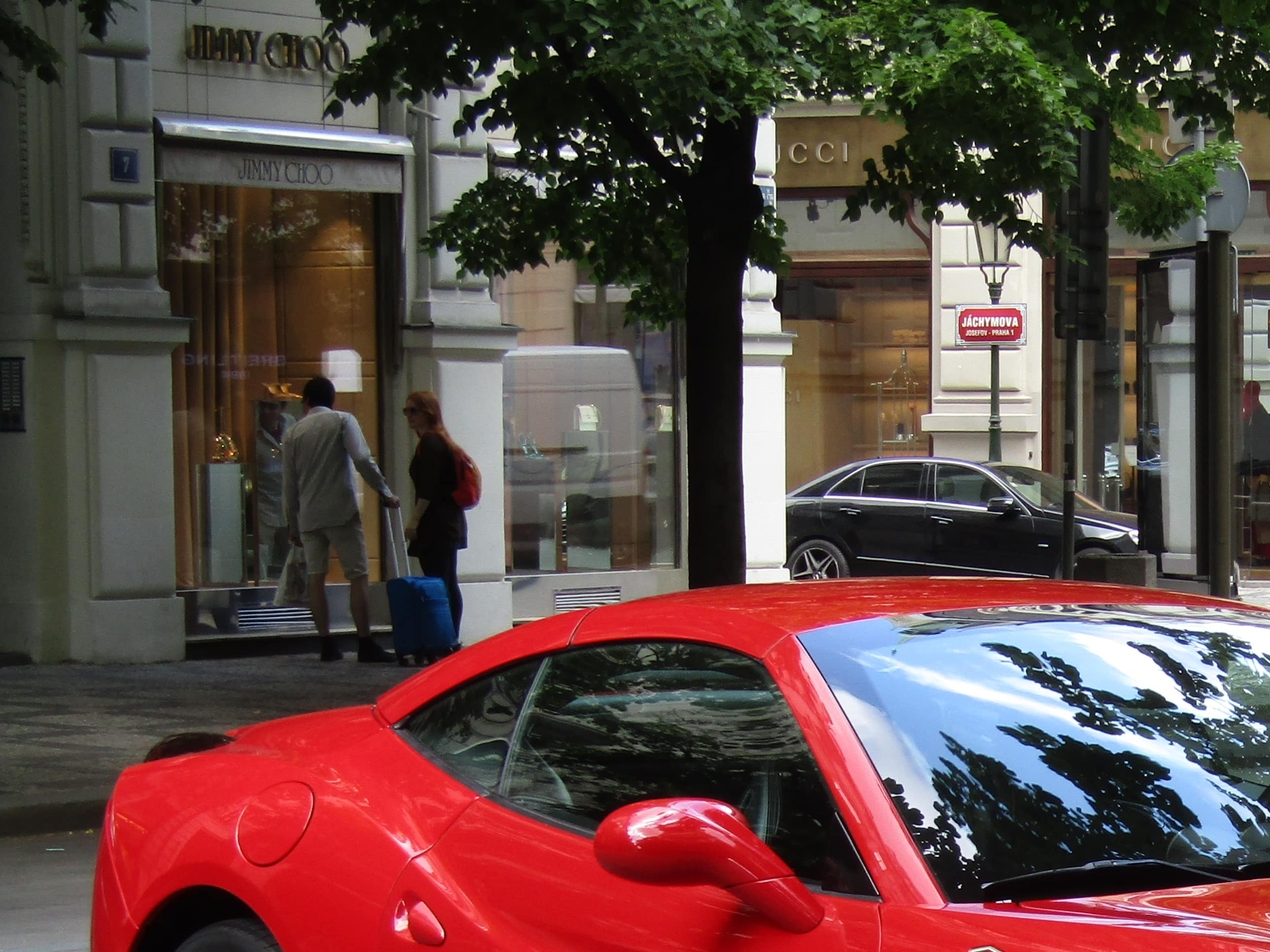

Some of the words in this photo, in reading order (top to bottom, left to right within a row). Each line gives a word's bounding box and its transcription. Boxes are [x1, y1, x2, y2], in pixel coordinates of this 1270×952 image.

[186, 24, 263, 65] JIMMY
[265, 32, 350, 73] CHOO
[776, 141, 848, 164] CCI
[122, 156, 131, 173] 7
[238, 158, 283, 182] JIMMY
[285, 161, 333, 185] CHOO
[961, 314, 1019, 328] JÁCHYMOVA
